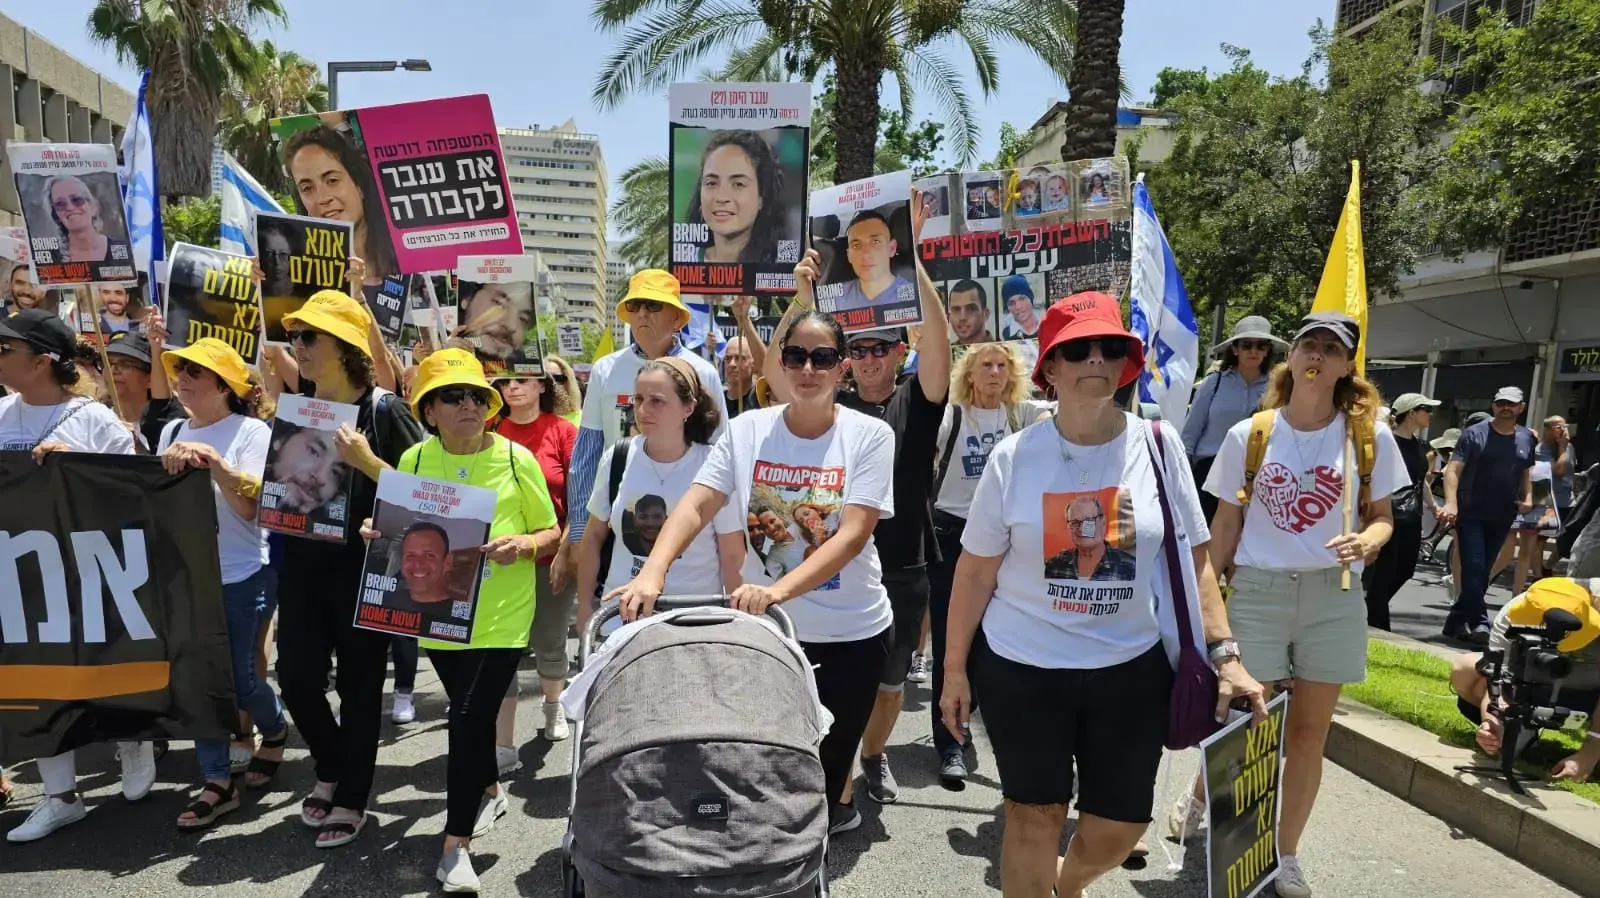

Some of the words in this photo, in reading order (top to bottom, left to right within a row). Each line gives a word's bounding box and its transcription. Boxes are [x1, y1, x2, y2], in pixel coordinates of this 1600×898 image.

[711, 90, 726, 106] (27)
[374, 141, 421, 159] דורשת
[426, 134, 494, 152] המשפחה
[382, 162, 446, 188] ענבר
[456, 155, 496, 180] את
[389, 180, 504, 221] לקבורה
[448, 230, 460, 240] כל
[463, 230, 476, 239] את
[479, 227, 506, 238] החזירו
[673, 223, 708, 242] BRING
[1006, 226, 1042, 253] כל
[32, 236, 58, 250] BRING
[305, 226, 345, 258] אמא
[922, 232, 1000, 260] החטופים
[34, 250, 53, 264] HER
[673, 243, 698, 262] HER
[224, 256, 253, 272] מא
[290, 255, 346, 288] לעולם
[970, 248, 1058, 278] עכשיו
[673, 265, 706, 285] HOME
[708, 264, 743, 285] NOW!
[816, 283, 844, 299] BRING
[819, 300, 837, 313] HIM
[848, 307, 874, 324] NOW!
[233, 302, 258, 331] לא
[758, 466, 838, 486] KIDNAPPED
[263, 481, 287, 496] BRING
[262, 497, 277, 508] HIM
[261, 510, 281, 524] HOME
[283, 513, 306, 529] NOW!
[366, 572, 397, 592] BRING
[363, 589, 383, 606] HIM
[1048, 584, 1077, 600] אברהם
[1080, 586, 1093, 600] את
[1096, 586, 1133, 600] מחזירים
[360, 604, 388, 623] HOME
[391, 610, 422, 629] NOW!
[1058, 602, 1088, 614] עכשיו
[1089, 603, 1119, 616] הביתה
[1245, 711, 1280, 764] אמא
[1234, 750, 1276, 817] לעולם
[1257, 790, 1274, 836] לא
[1226, 830, 1274, 898] מוותרת
